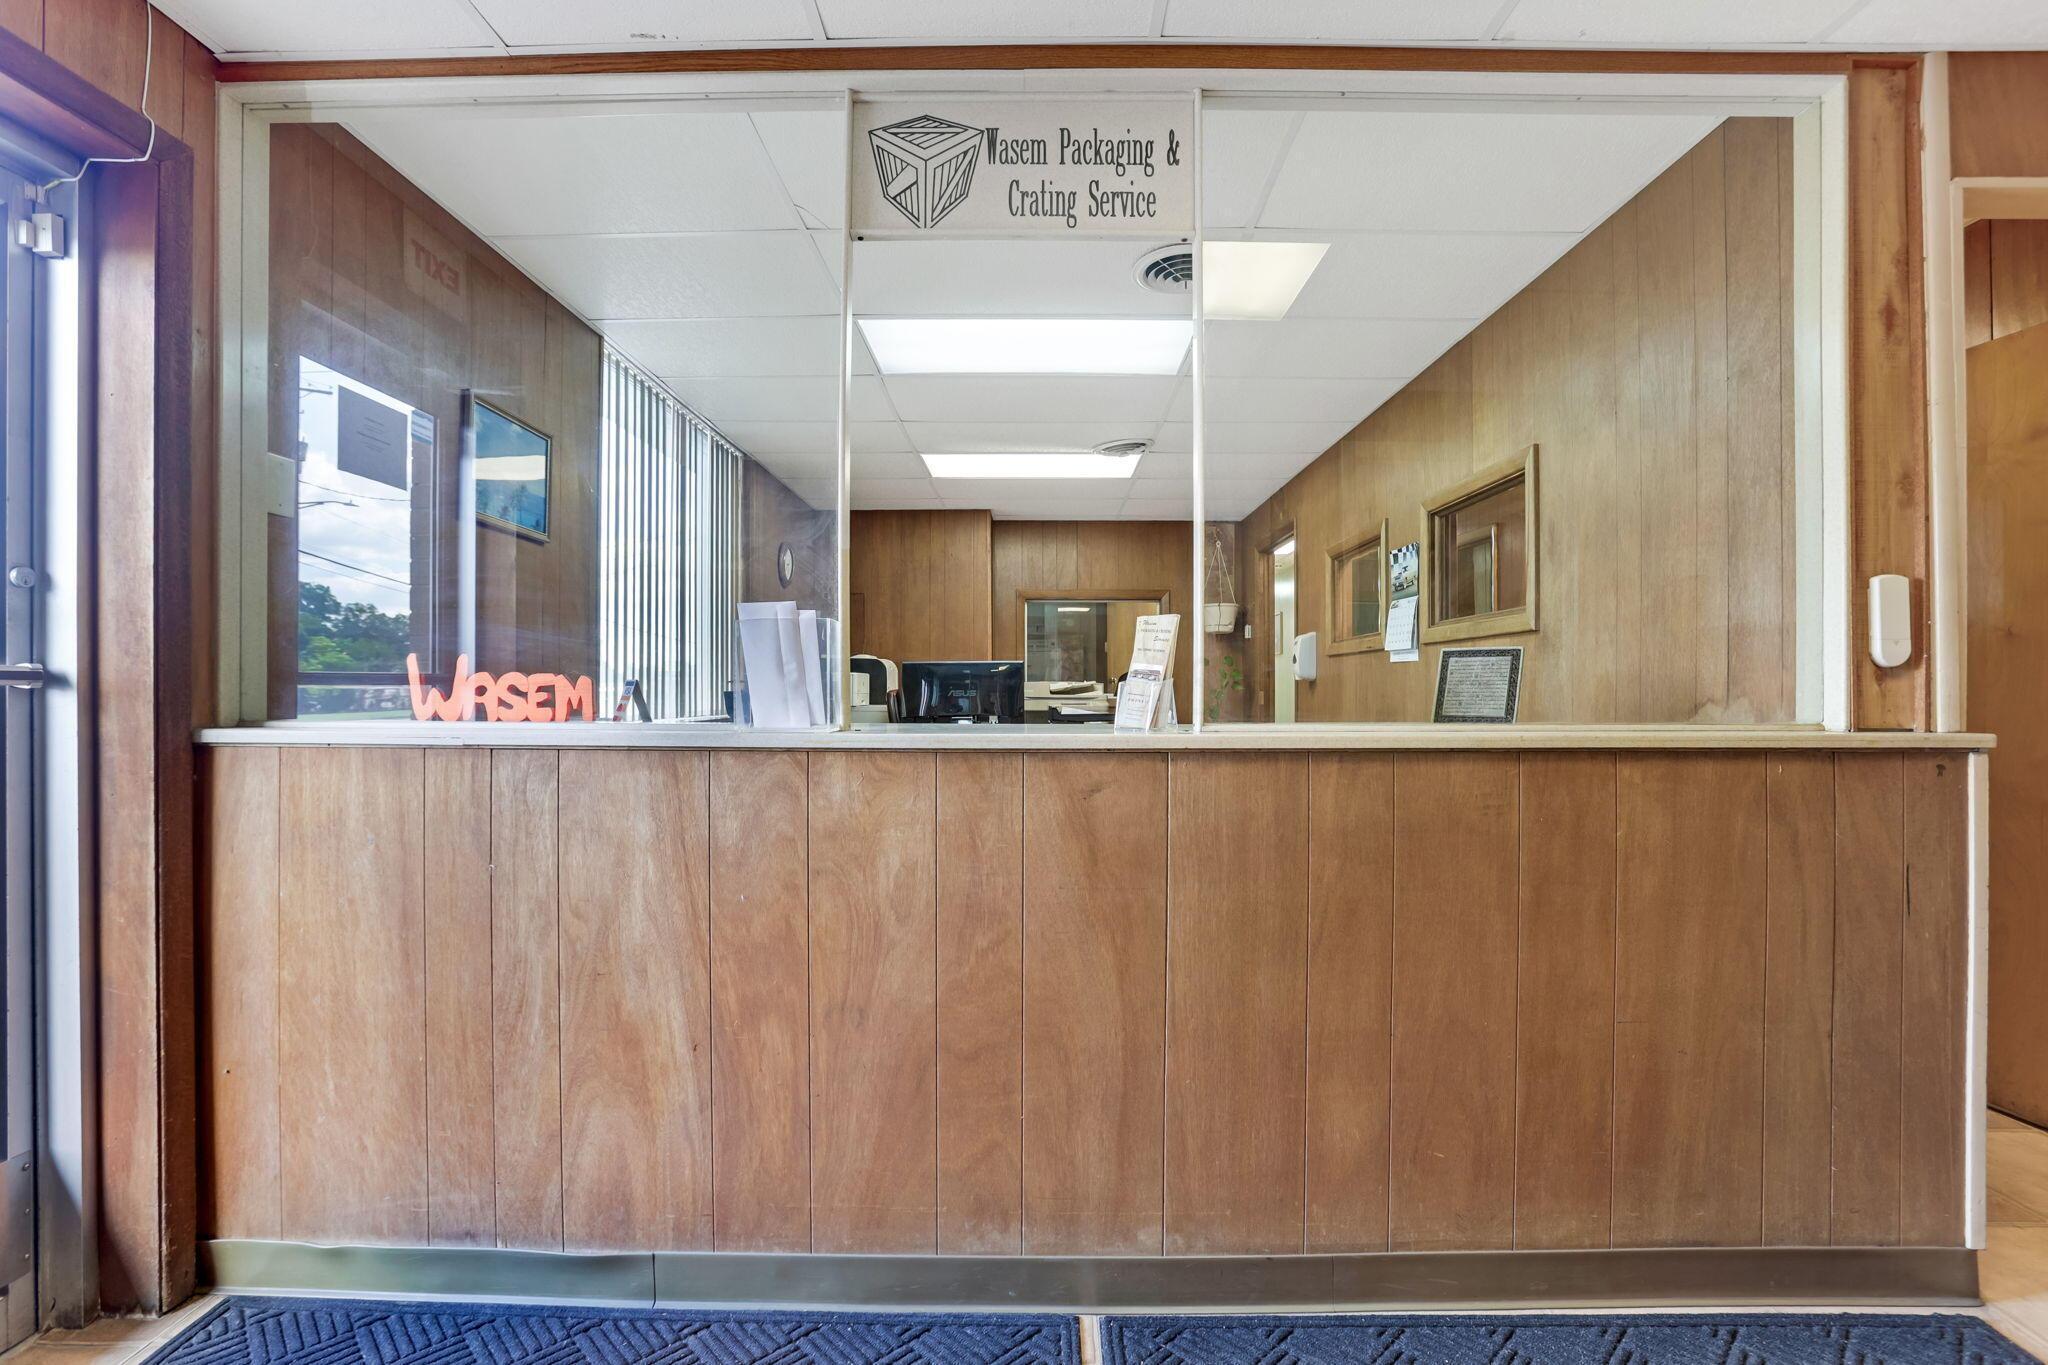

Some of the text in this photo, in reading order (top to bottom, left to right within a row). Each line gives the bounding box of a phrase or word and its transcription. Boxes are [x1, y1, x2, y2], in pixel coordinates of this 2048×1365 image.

[985, 127, 1180, 177] Wasem Packaging &
[1008, 179, 1157, 228] Crating Service
[406, 653, 596, 722] WASEM
[947, 687, 977, 697] ASUS
